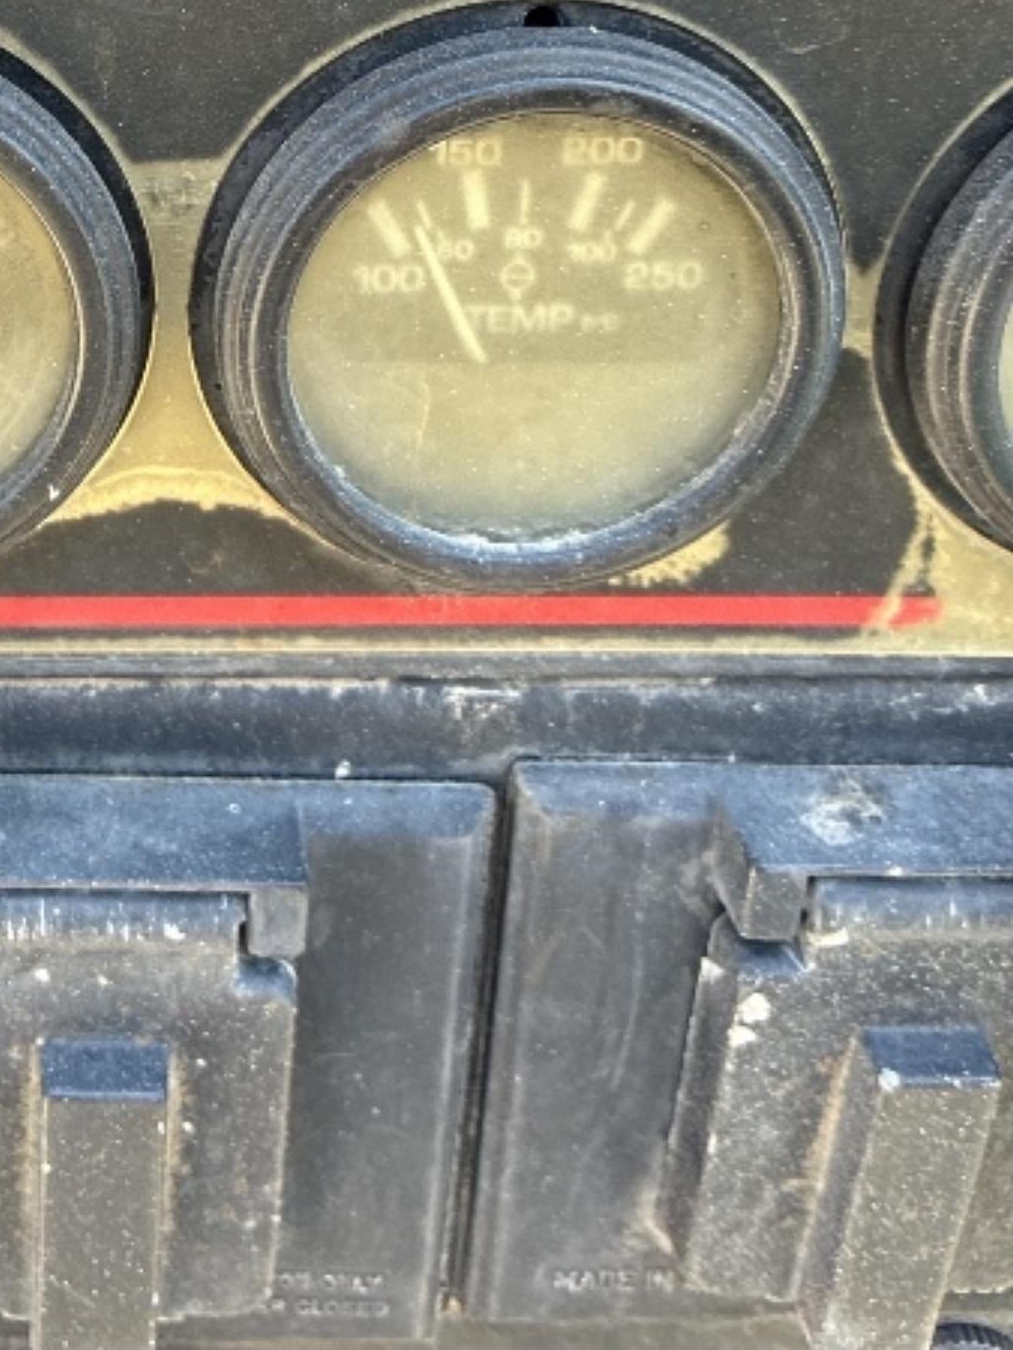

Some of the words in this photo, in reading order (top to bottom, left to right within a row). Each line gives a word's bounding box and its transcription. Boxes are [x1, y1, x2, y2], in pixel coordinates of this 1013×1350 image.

[436, 137, 503, 167] 150
[561, 136, 645, 166] 200
[355, 264, 426, 295] 100
[623, 262, 704, 292] 250
[466, 303, 575, 333] TEMP
[553, 1270, 636, 1293] MADE
